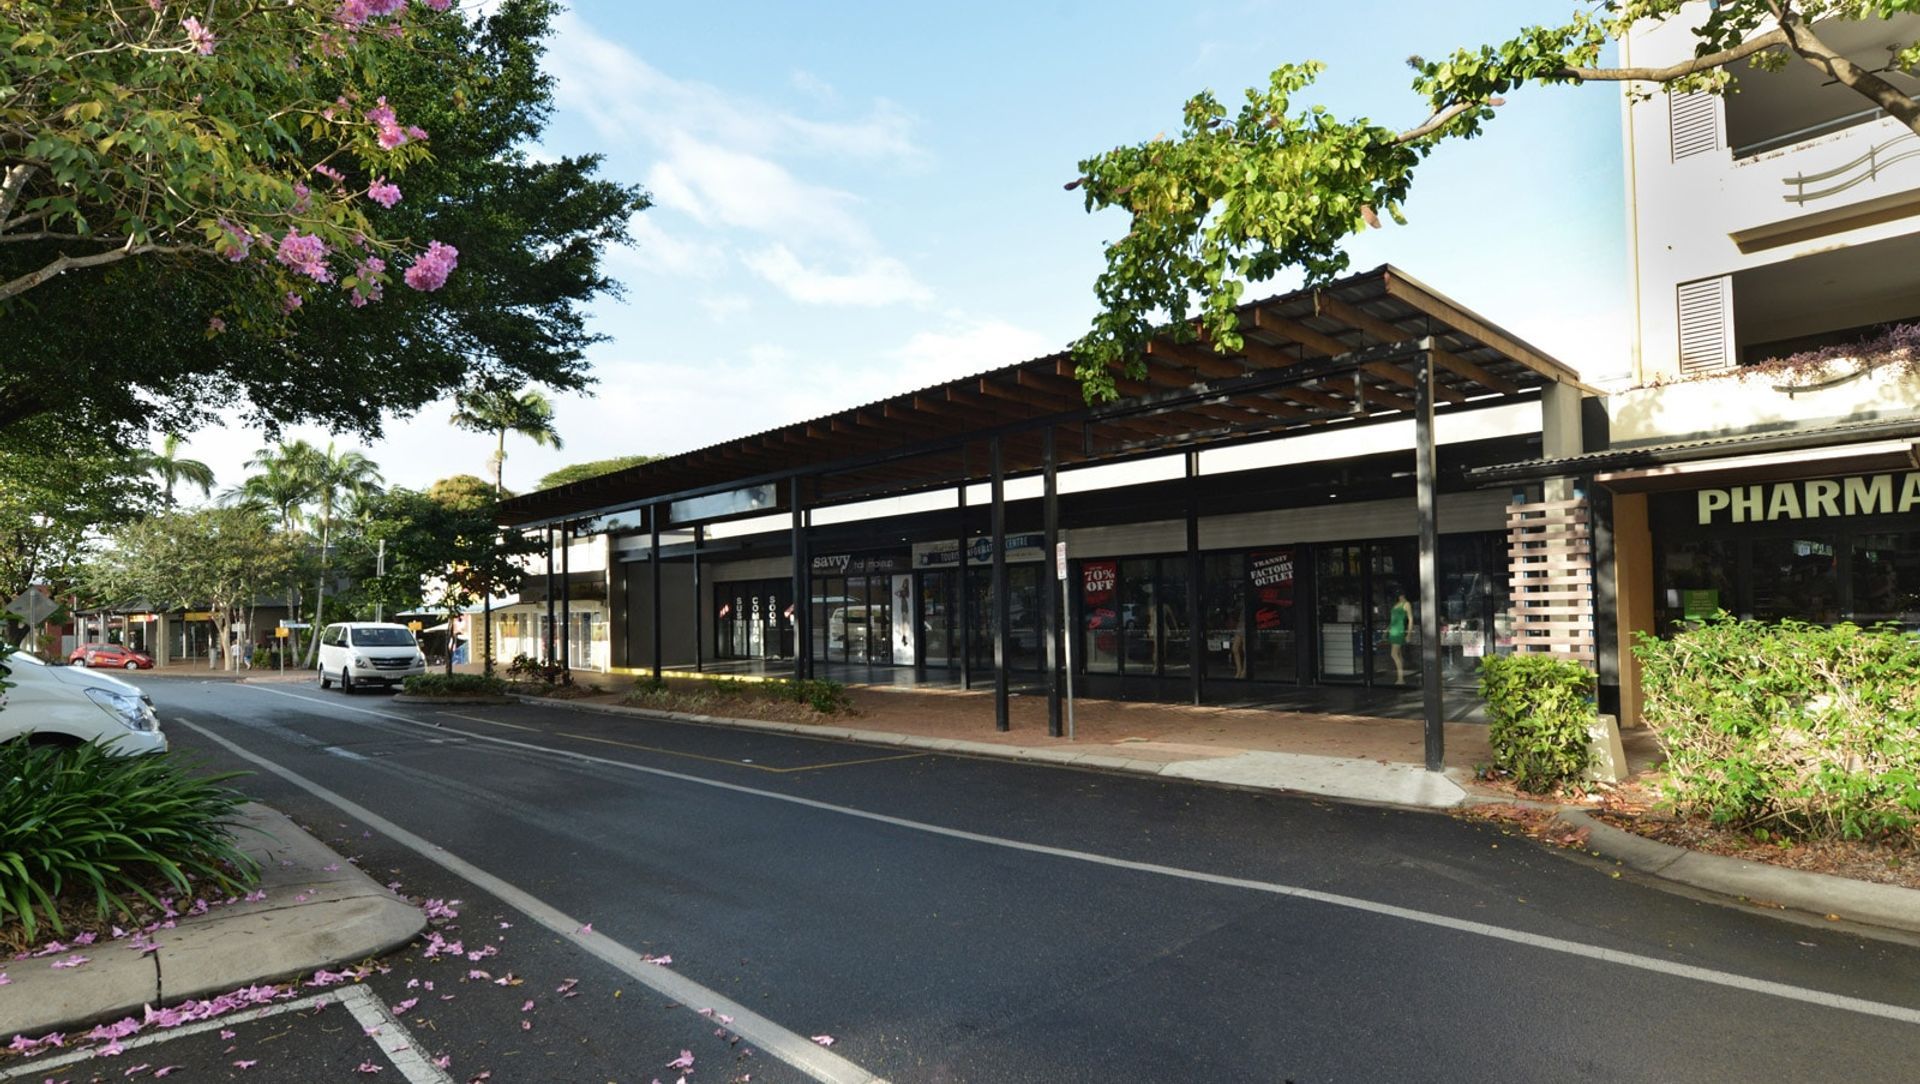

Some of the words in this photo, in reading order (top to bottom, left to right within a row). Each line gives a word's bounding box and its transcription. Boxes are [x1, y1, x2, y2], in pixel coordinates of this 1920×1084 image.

[813, 554, 851, 574] savvy
[1250, 561, 1294, 580] FACTORY
[1084, 569, 1116, 582] 70%
[1254, 570, 1294, 587] OUTLET
[1086, 580, 1115, 592] OFF
[752, 596, 760, 643] COMING
[768, 595, 777, 628] SOON
